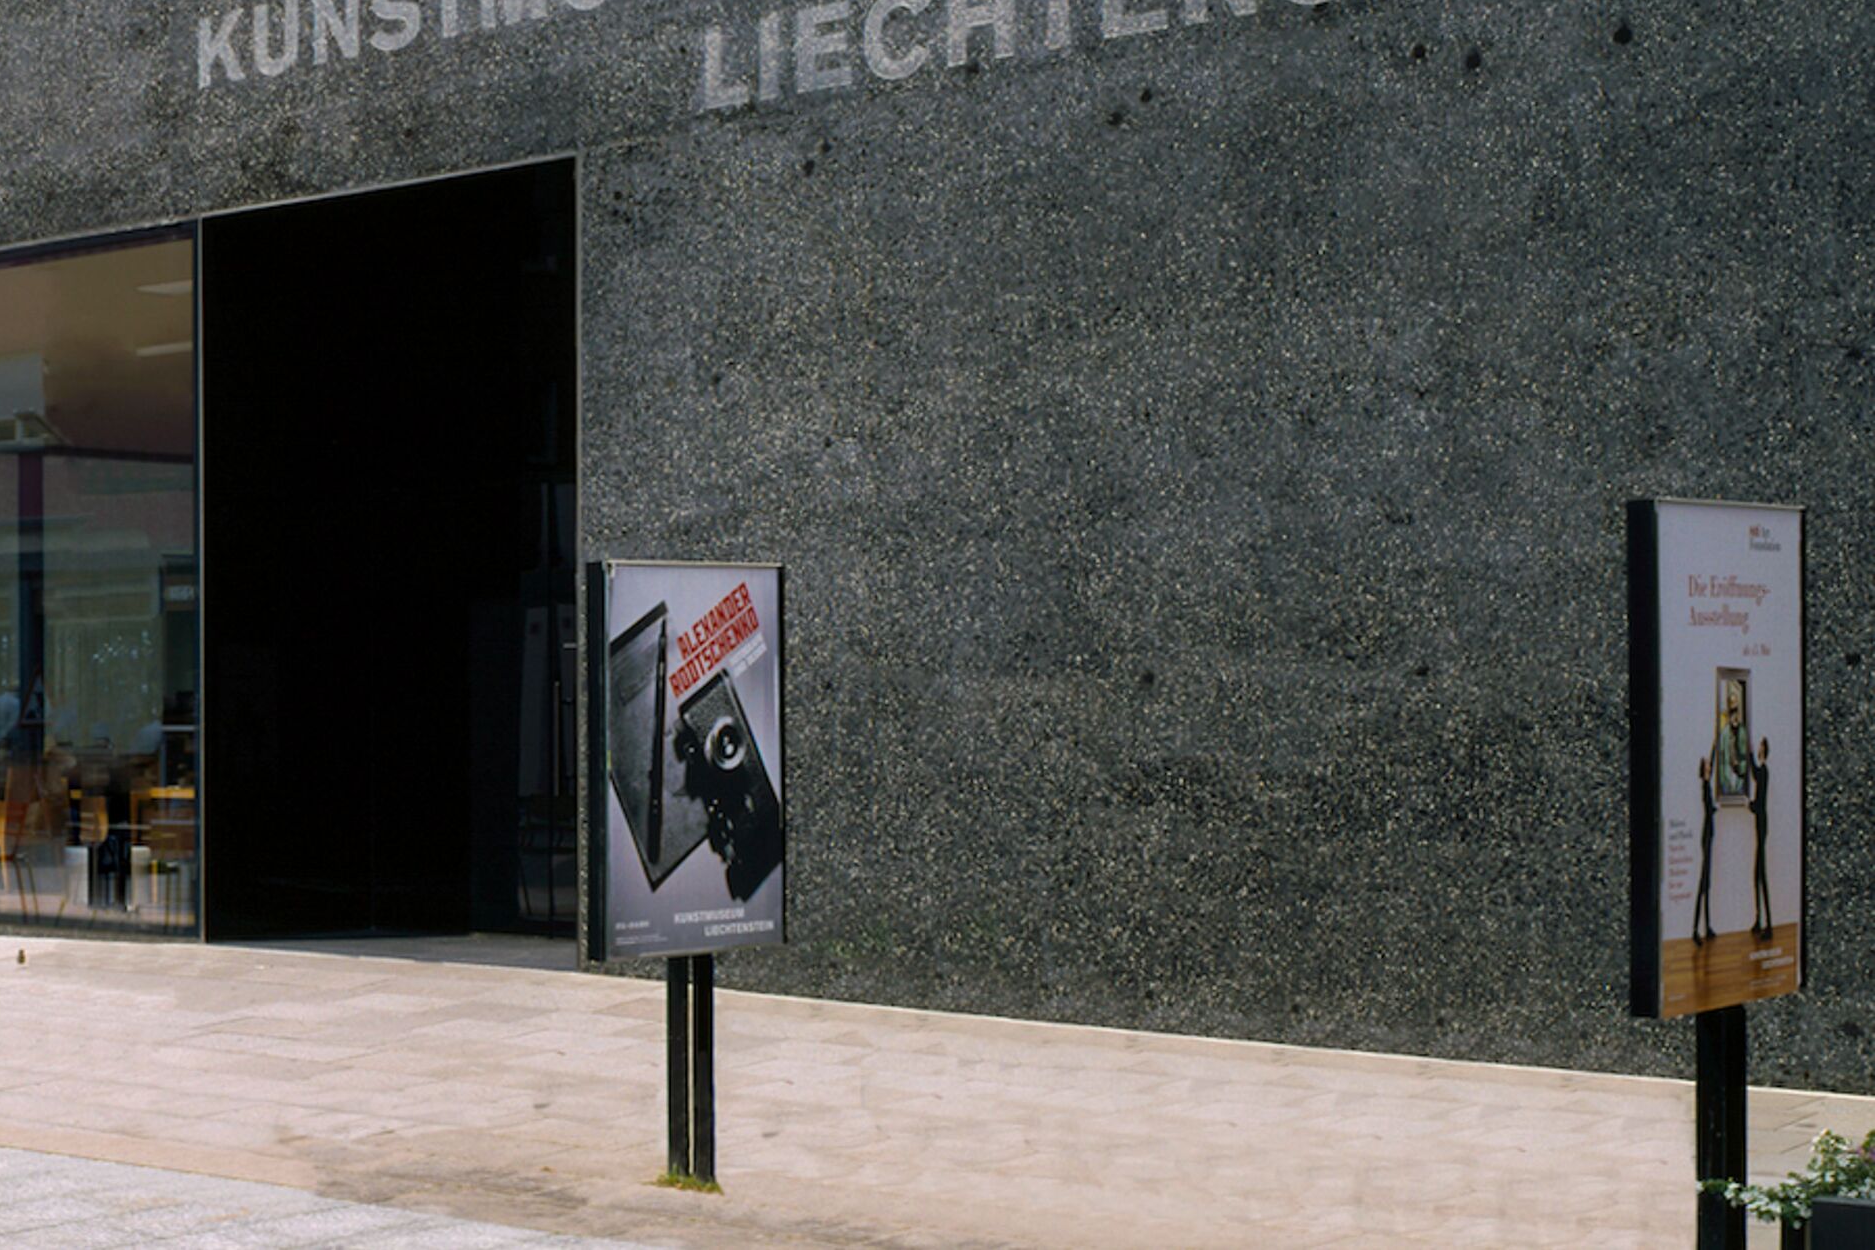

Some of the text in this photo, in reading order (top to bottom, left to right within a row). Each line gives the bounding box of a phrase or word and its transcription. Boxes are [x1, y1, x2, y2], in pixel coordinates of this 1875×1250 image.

[1688, 574, 1707, 598] Die
[676, 581, 751, 660] ALEXANDER
[673, 907, 746, 924] KUNSTMUSEUM
[703, 920, 775, 937] LIECHTENSTEIN
